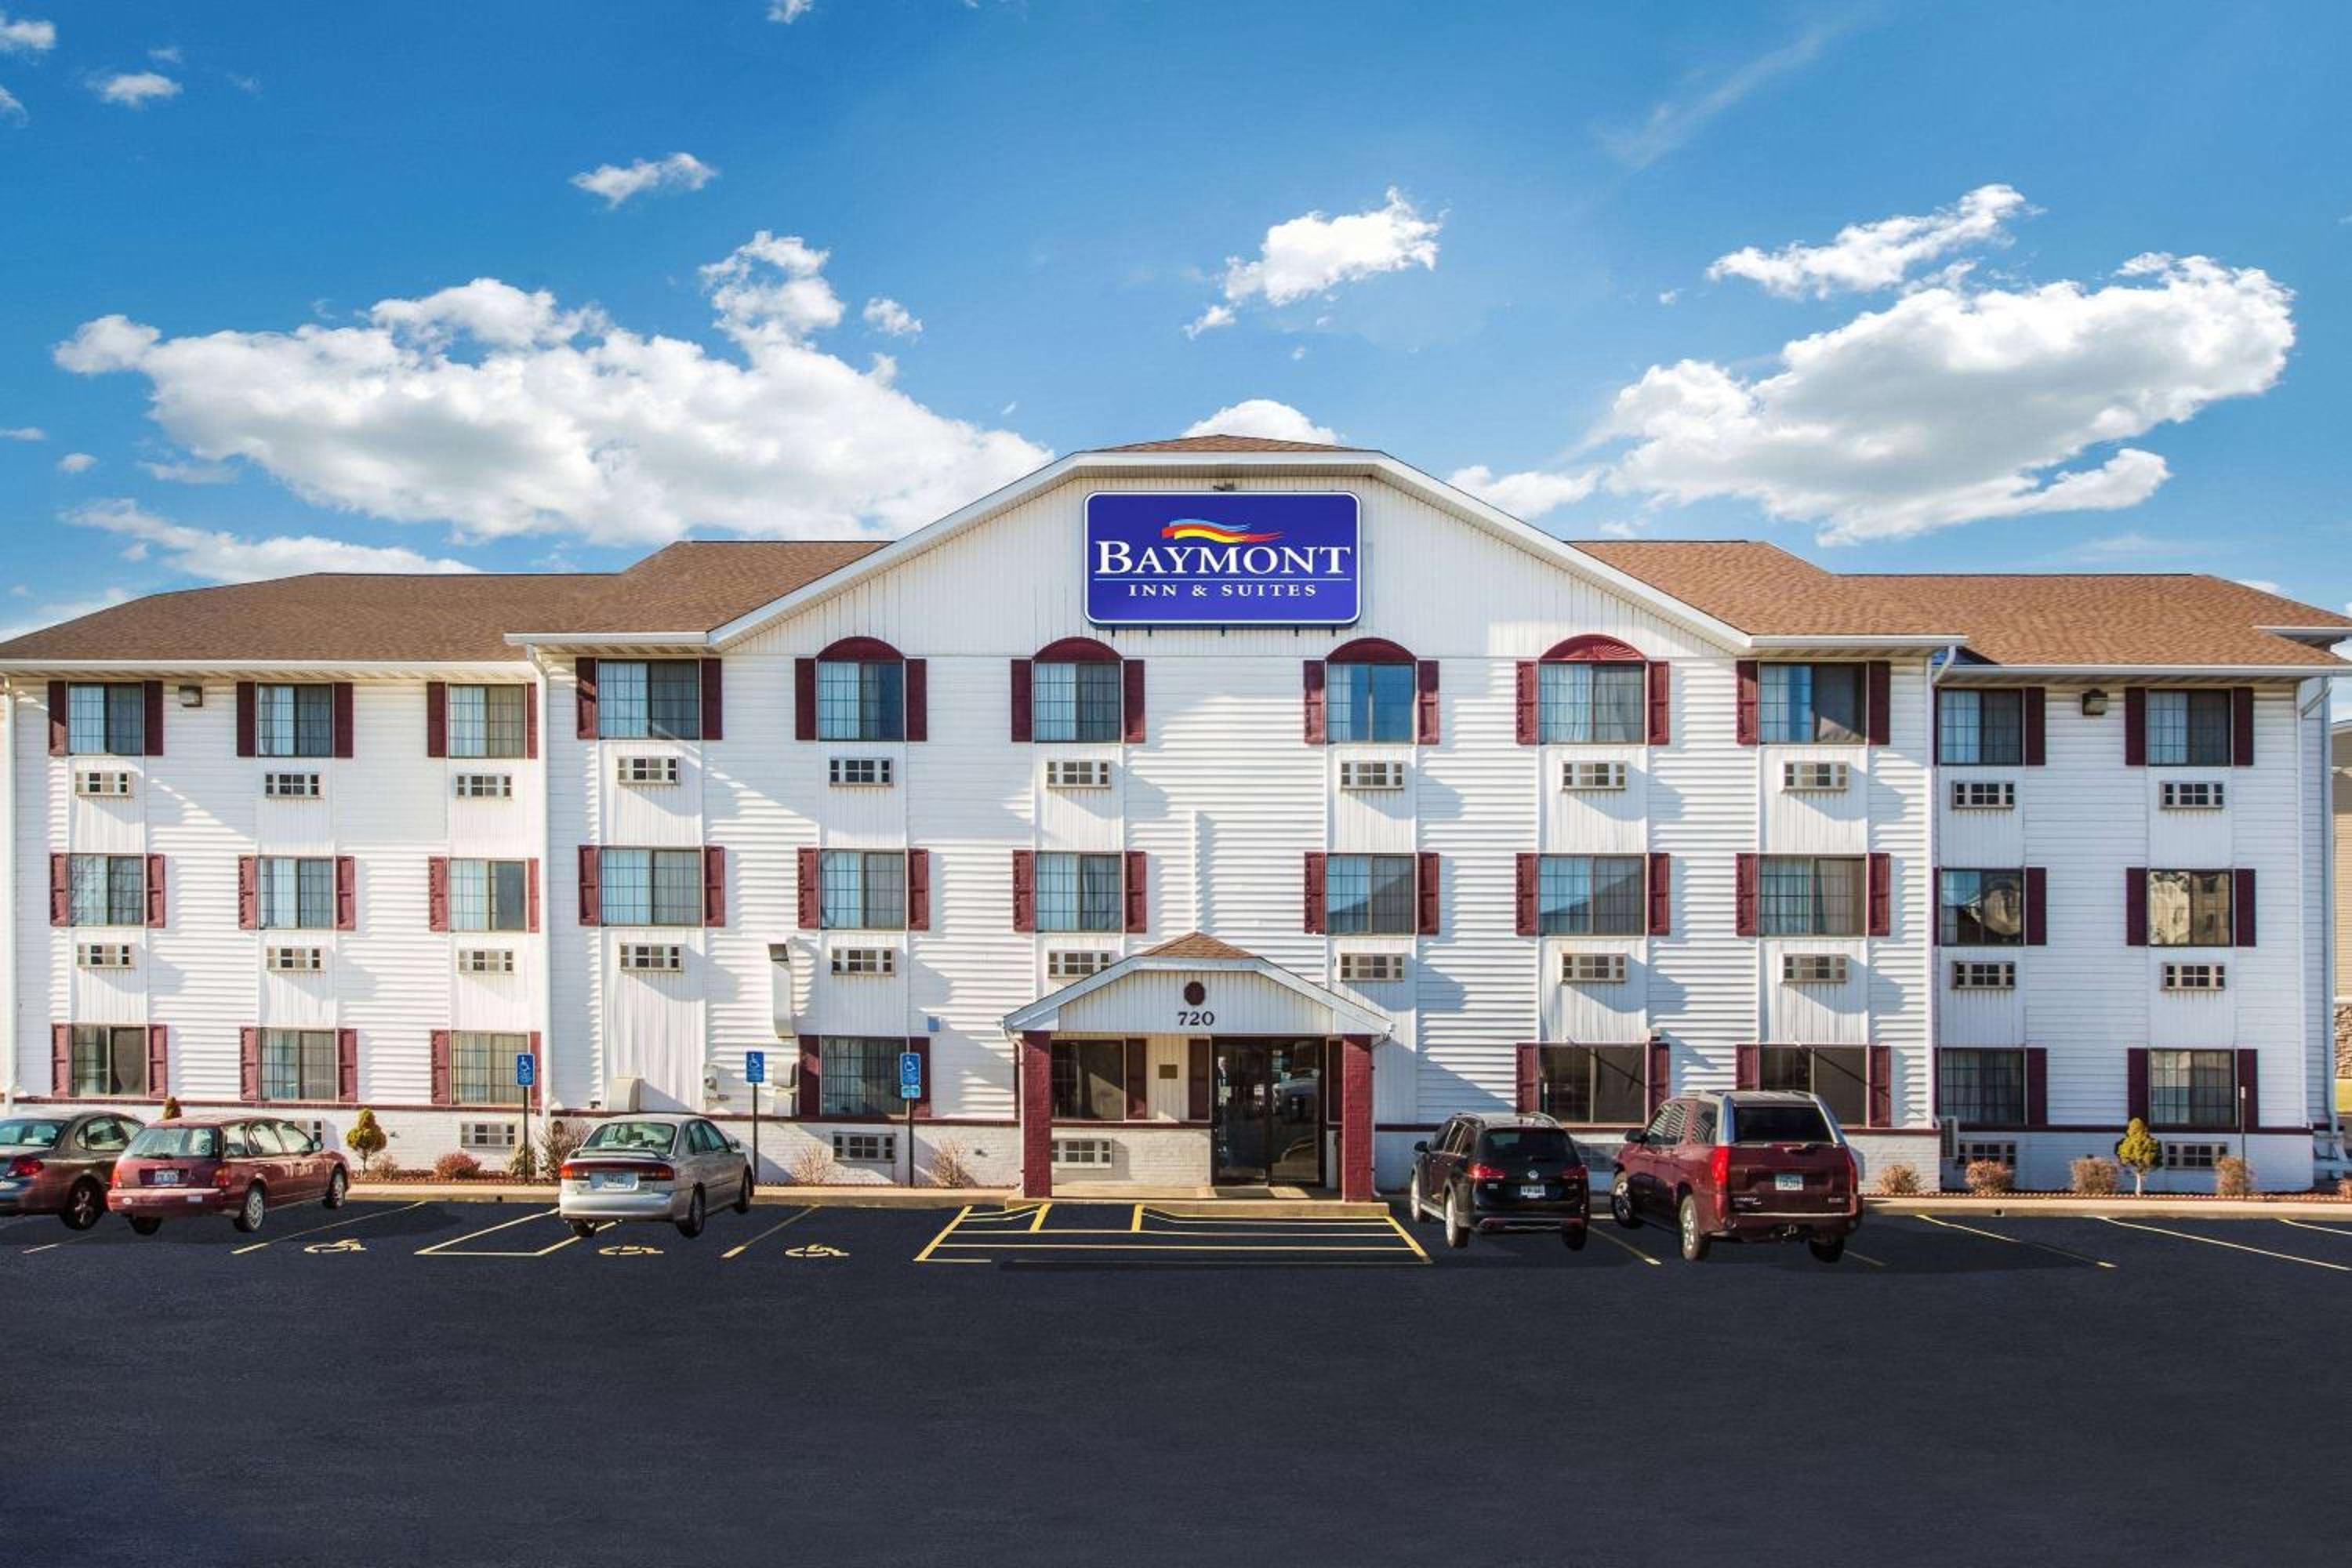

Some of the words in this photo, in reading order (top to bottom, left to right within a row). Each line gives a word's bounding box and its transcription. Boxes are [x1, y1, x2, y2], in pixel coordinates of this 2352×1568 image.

[1094, 540, 1351, 575] BAYMONT
[1128, 584, 1177, 597] INN
[1191, 584, 1208, 597] &
[1221, 584, 1317, 597] SUITES
[1178, 1011, 1214, 1026] 720
